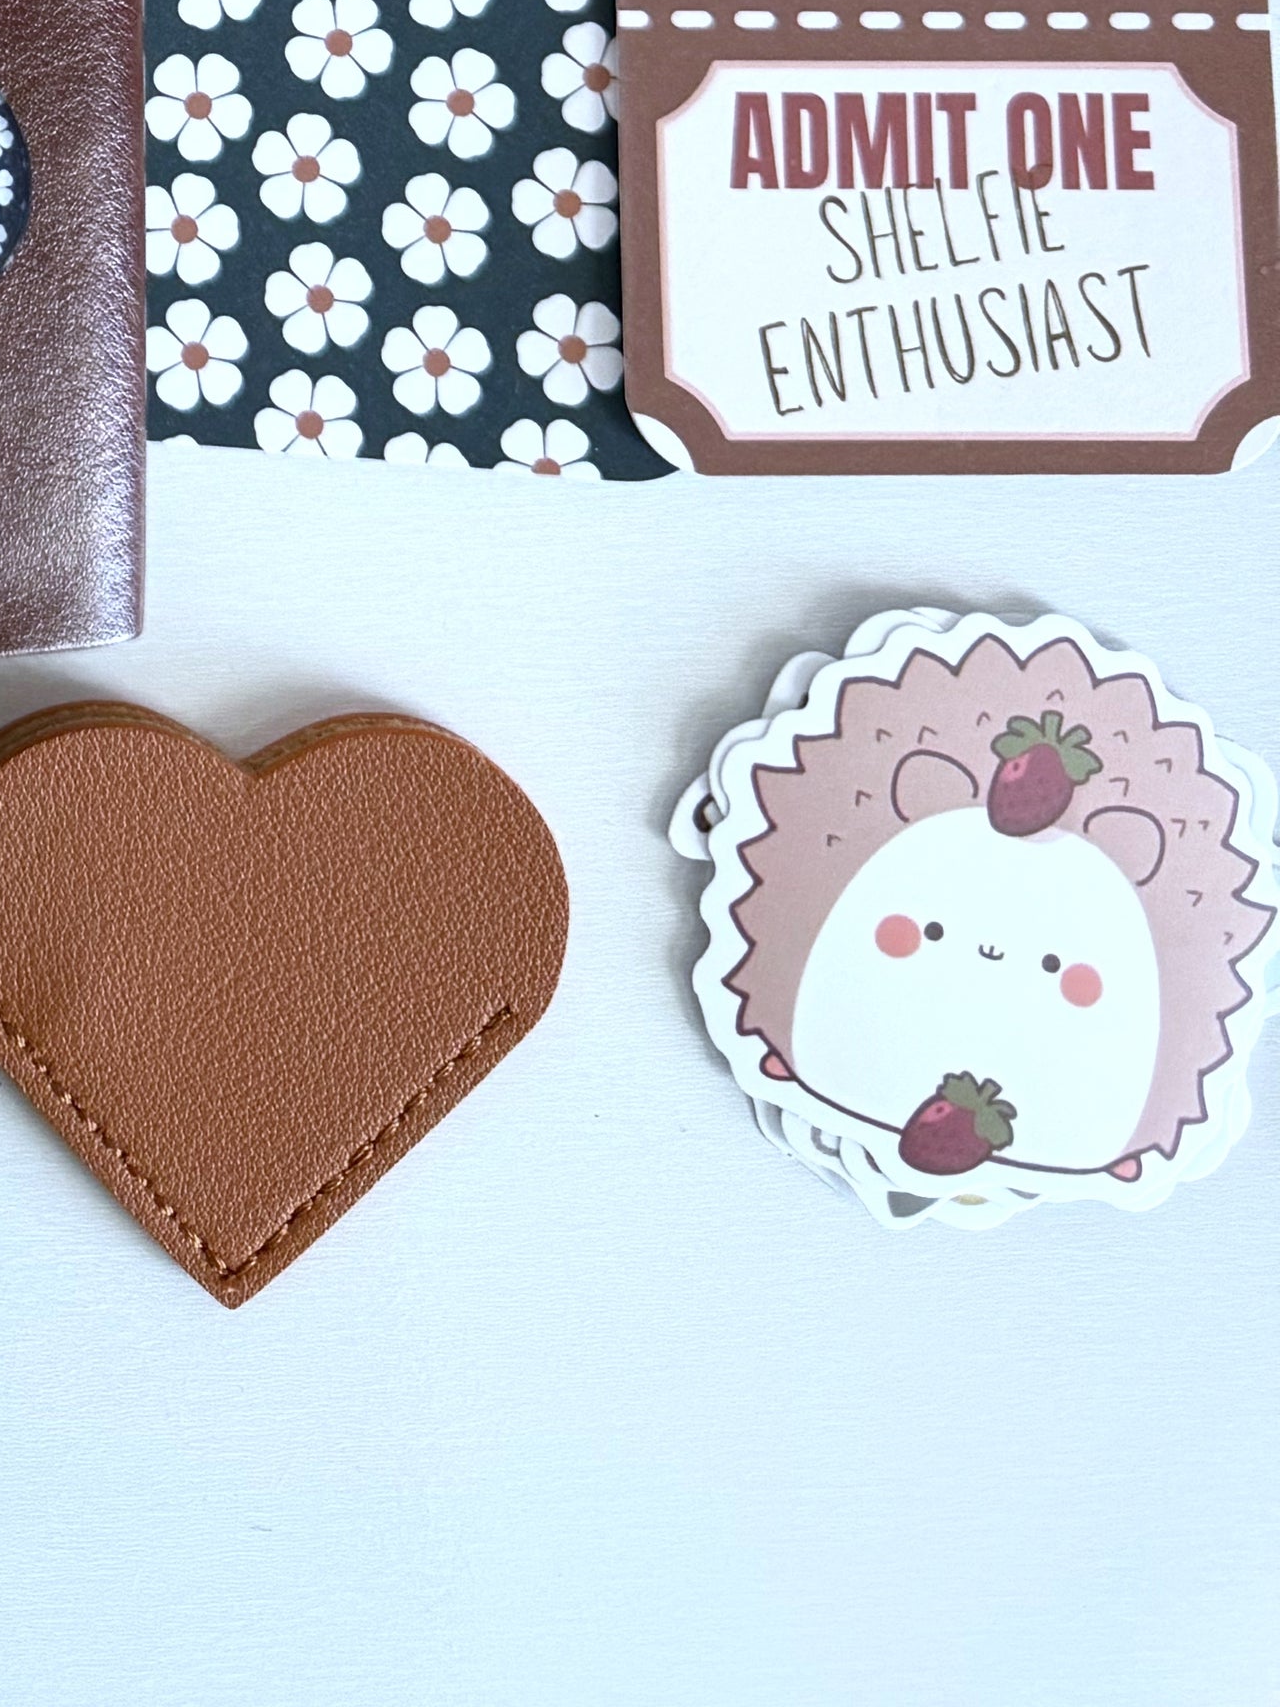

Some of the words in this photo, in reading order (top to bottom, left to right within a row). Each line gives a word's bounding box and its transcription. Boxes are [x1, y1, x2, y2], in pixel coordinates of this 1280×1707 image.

[729, 91, 978, 191] ADMIT
[1007, 91, 1156, 191] ONE
[819, 162, 1066, 286] SHELFIE
[758, 262, 1152, 418] ENTHUSIAST
